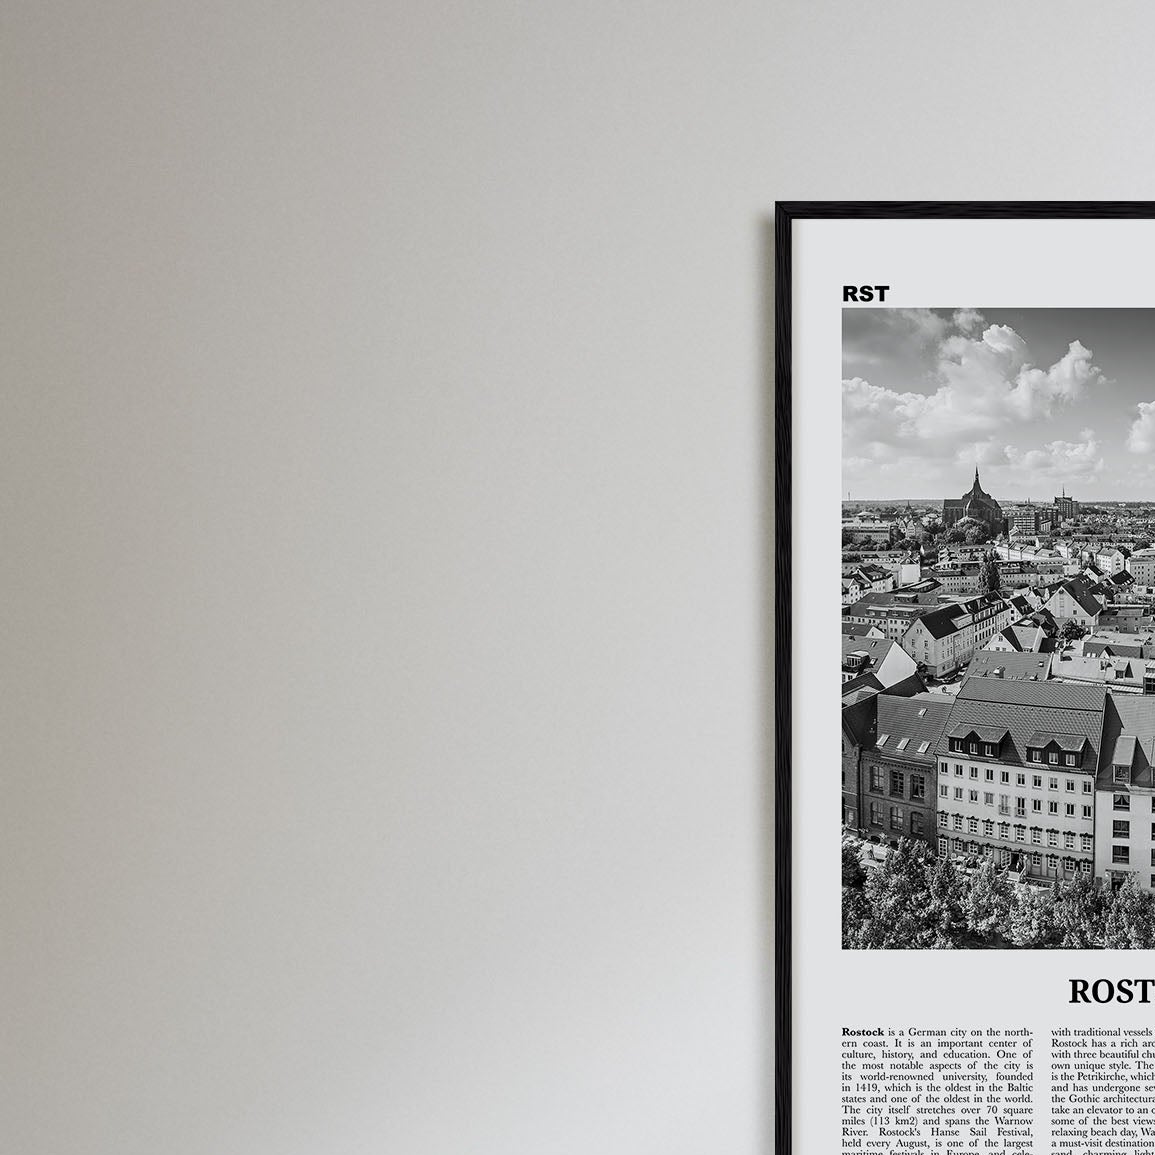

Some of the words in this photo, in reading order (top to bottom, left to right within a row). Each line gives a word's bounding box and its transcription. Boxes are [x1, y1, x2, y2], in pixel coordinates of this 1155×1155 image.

[843, 286, 889, 302] RST
[841, 1027, 885, 1037] Rostock
[888, 1027, 896, 1037] is
[908, 1027, 947, 1037] German
[950, 1027, 967, 1039] city
[986, 1027, 1001, 1037] the
[1004, 1027, 1033, 1037] north-
[1051, 1027, 1071, 1037] with
[1073, 1027, 1121, 1037] traditional
[1123, 1027, 1153, 1037] vessels
[841, 1050, 876, 1060] culture,
[881, 1050, 915, 1061] history,
[919, 1050, 938, 1059] and
[942, 1050, 991, 1059] education.
[996, 1050, 1017, 1059] One
[1022, 1050, 1033, 1059] of
[1051, 1050, 1071, 1059] with
[1073, 1050, 1097, 1059] three
[1099, 1050, 1140, 1059] beautiful
[841, 1072, 853, 1081] its
[859, 1072, 934, 1081] world-renowned
[942, 1072, 988, 1083] university,
[996, 1072, 1034, 1081] founded
[1051, 1072, 1059, 1081] is
[1060, 1072, 1075, 1081] the
[1077, 1072, 1128, 1082] Petrikirche,
[841, 1094, 867, 1103] states
[869, 1094, 888, 1103] and
[911, 1094, 921, 1103] of
[925, 1094, 940, 1103] the
[943, 1094, 970, 1103] oldest
[973, 1094, 983, 1103] in
[986, 1094, 1001, 1103] the
[1004, 1094, 1033, 1103] world.
[1051, 1094, 1066, 1103] the
[1068, 1094, 1101, 1103] Gothic
[841, 1116, 866, 1126] miles
[870, 1116, 890, 1128] (113
[895, 1116, 918, 1128] km2)
[922, 1116, 941, 1126] and
[944, 1119, 971, 1128] spans
[975, 1116, 990, 1126] the
[994, 1116, 1034, 1126] Warnow
[1078, 1116, 1089, 1126] of
[1092, 1116, 1108, 1126] the
[1111, 1116, 1129, 1126] best
[841, 1138, 862, 1148] held
[866, 1141, 891, 1150] every
[895, 1138, 931, 1150] August,
[935, 1138, 943, 1148] is
[968, 1138, 979, 1148] of
[984, 1138, 999, 1148] the
[1003, 1138, 1033, 1150] largest
[1059, 1138, 1103, 1148] must-visit
